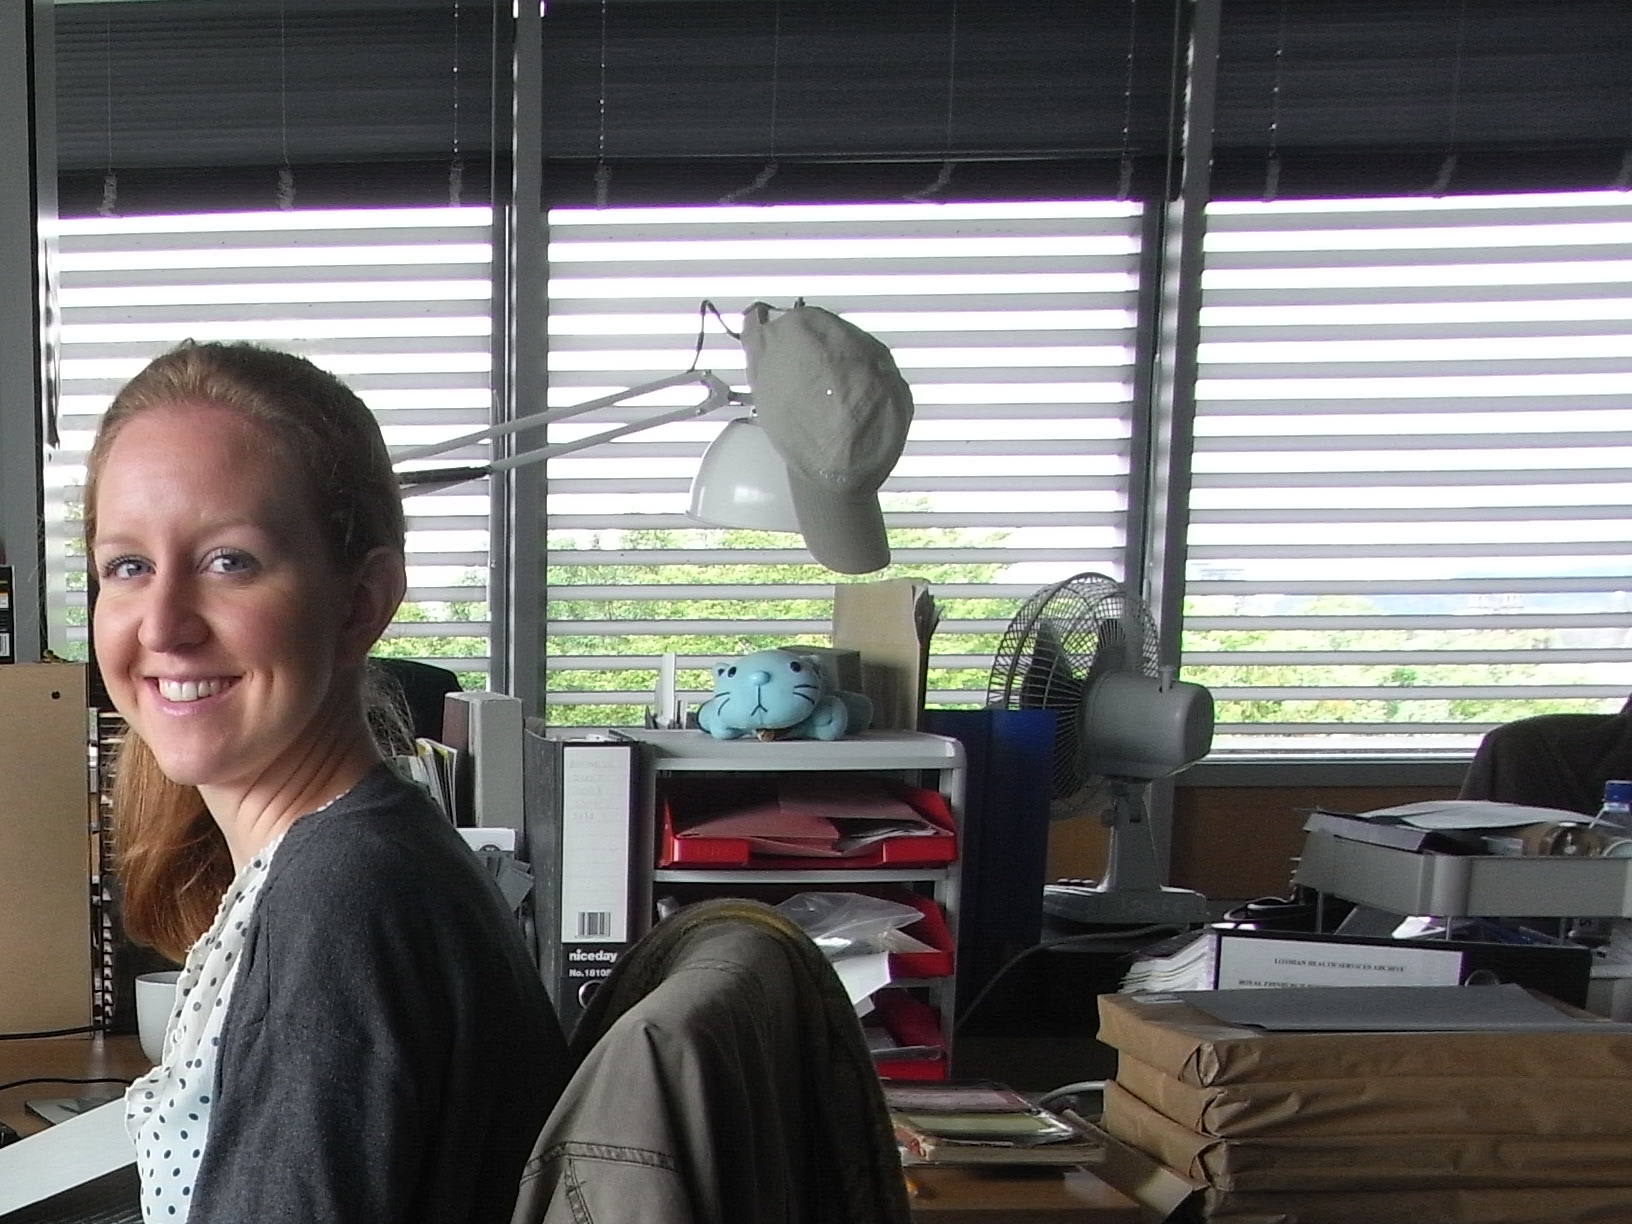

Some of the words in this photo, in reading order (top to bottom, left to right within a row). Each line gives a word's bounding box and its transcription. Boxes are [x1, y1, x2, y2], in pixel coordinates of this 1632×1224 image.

[568, 948, 618, 963] niceday
[1307, 960, 1337, 968] HEALTH
[1338, 962, 1372, 970] SERVICES
